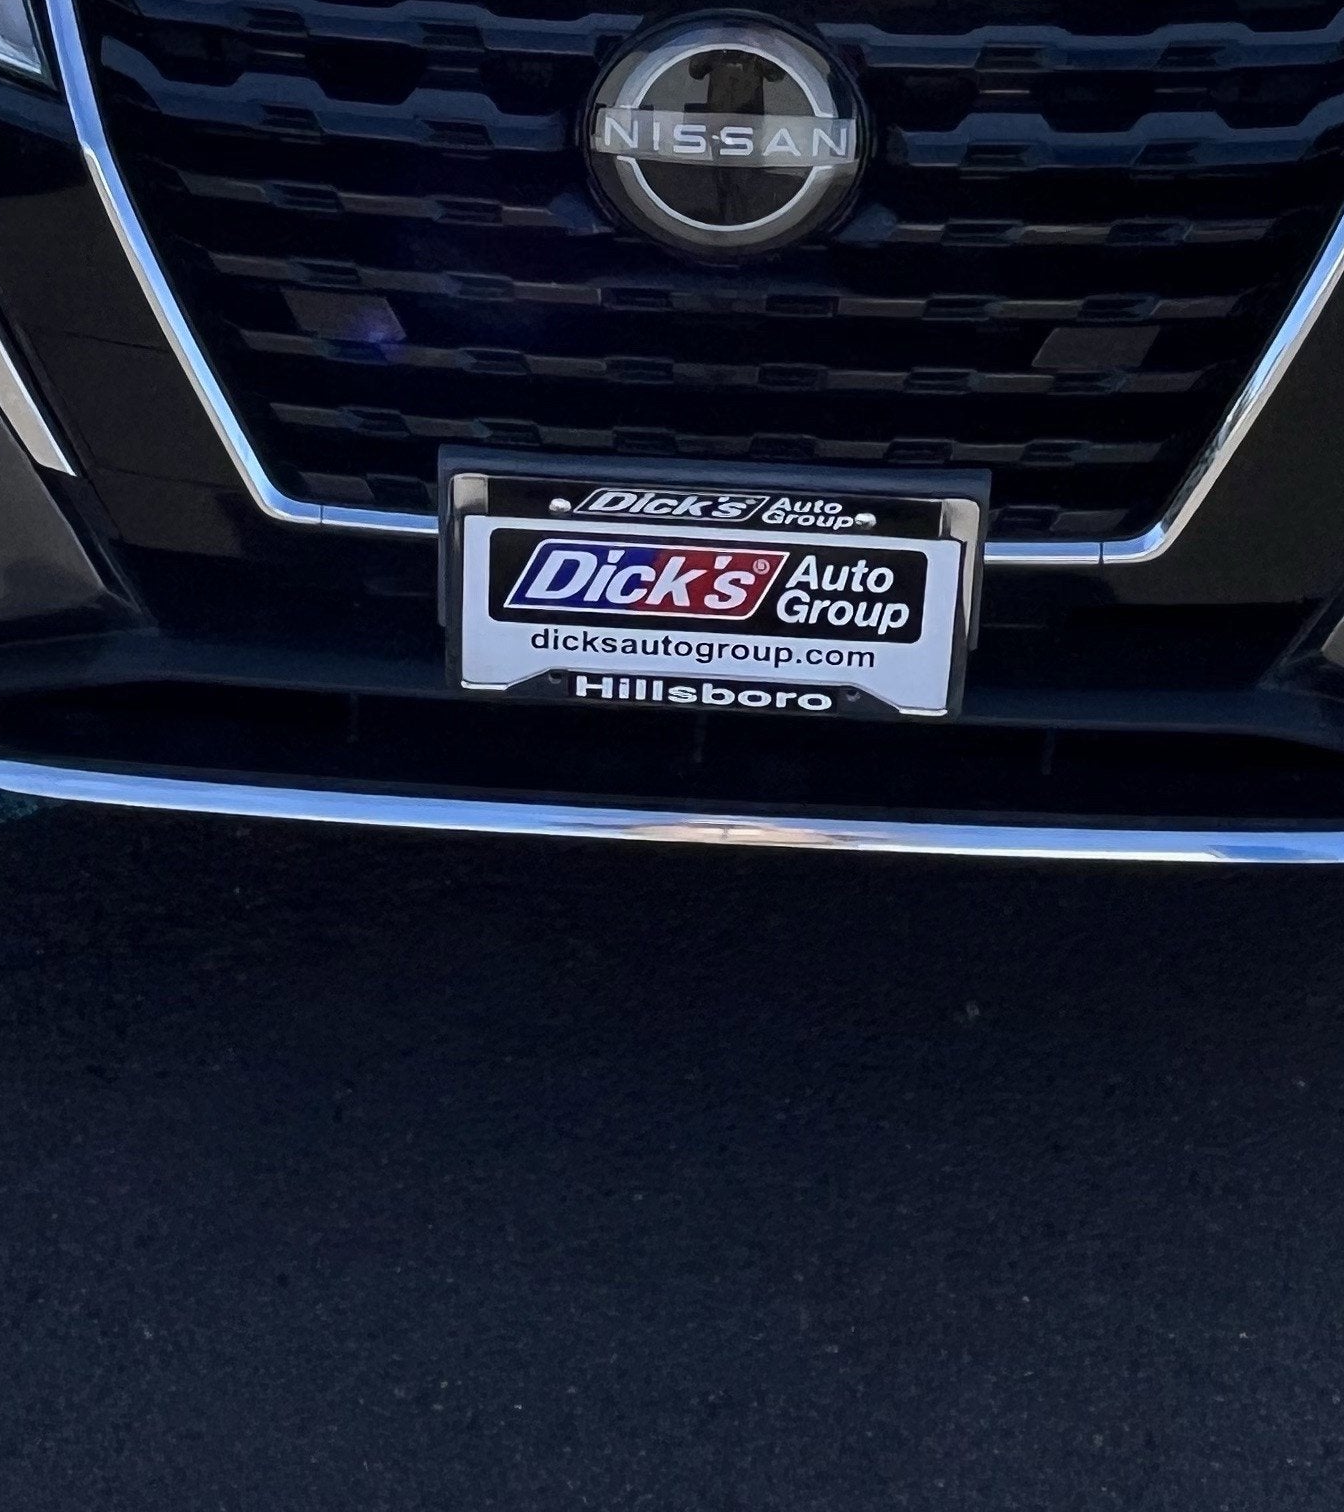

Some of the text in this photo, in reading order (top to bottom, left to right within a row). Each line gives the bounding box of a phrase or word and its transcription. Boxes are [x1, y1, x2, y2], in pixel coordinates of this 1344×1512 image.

[604, 116, 847, 157] NISSAN
[761, 509, 855, 530] Group
[768, 497, 843, 514] Auto
[785, 555, 895, 594] Auto
[776, 590, 911, 635] Group
[530, 627, 876, 668] dicksautogroup.com
[575, 675, 833, 711] Hillsboro
